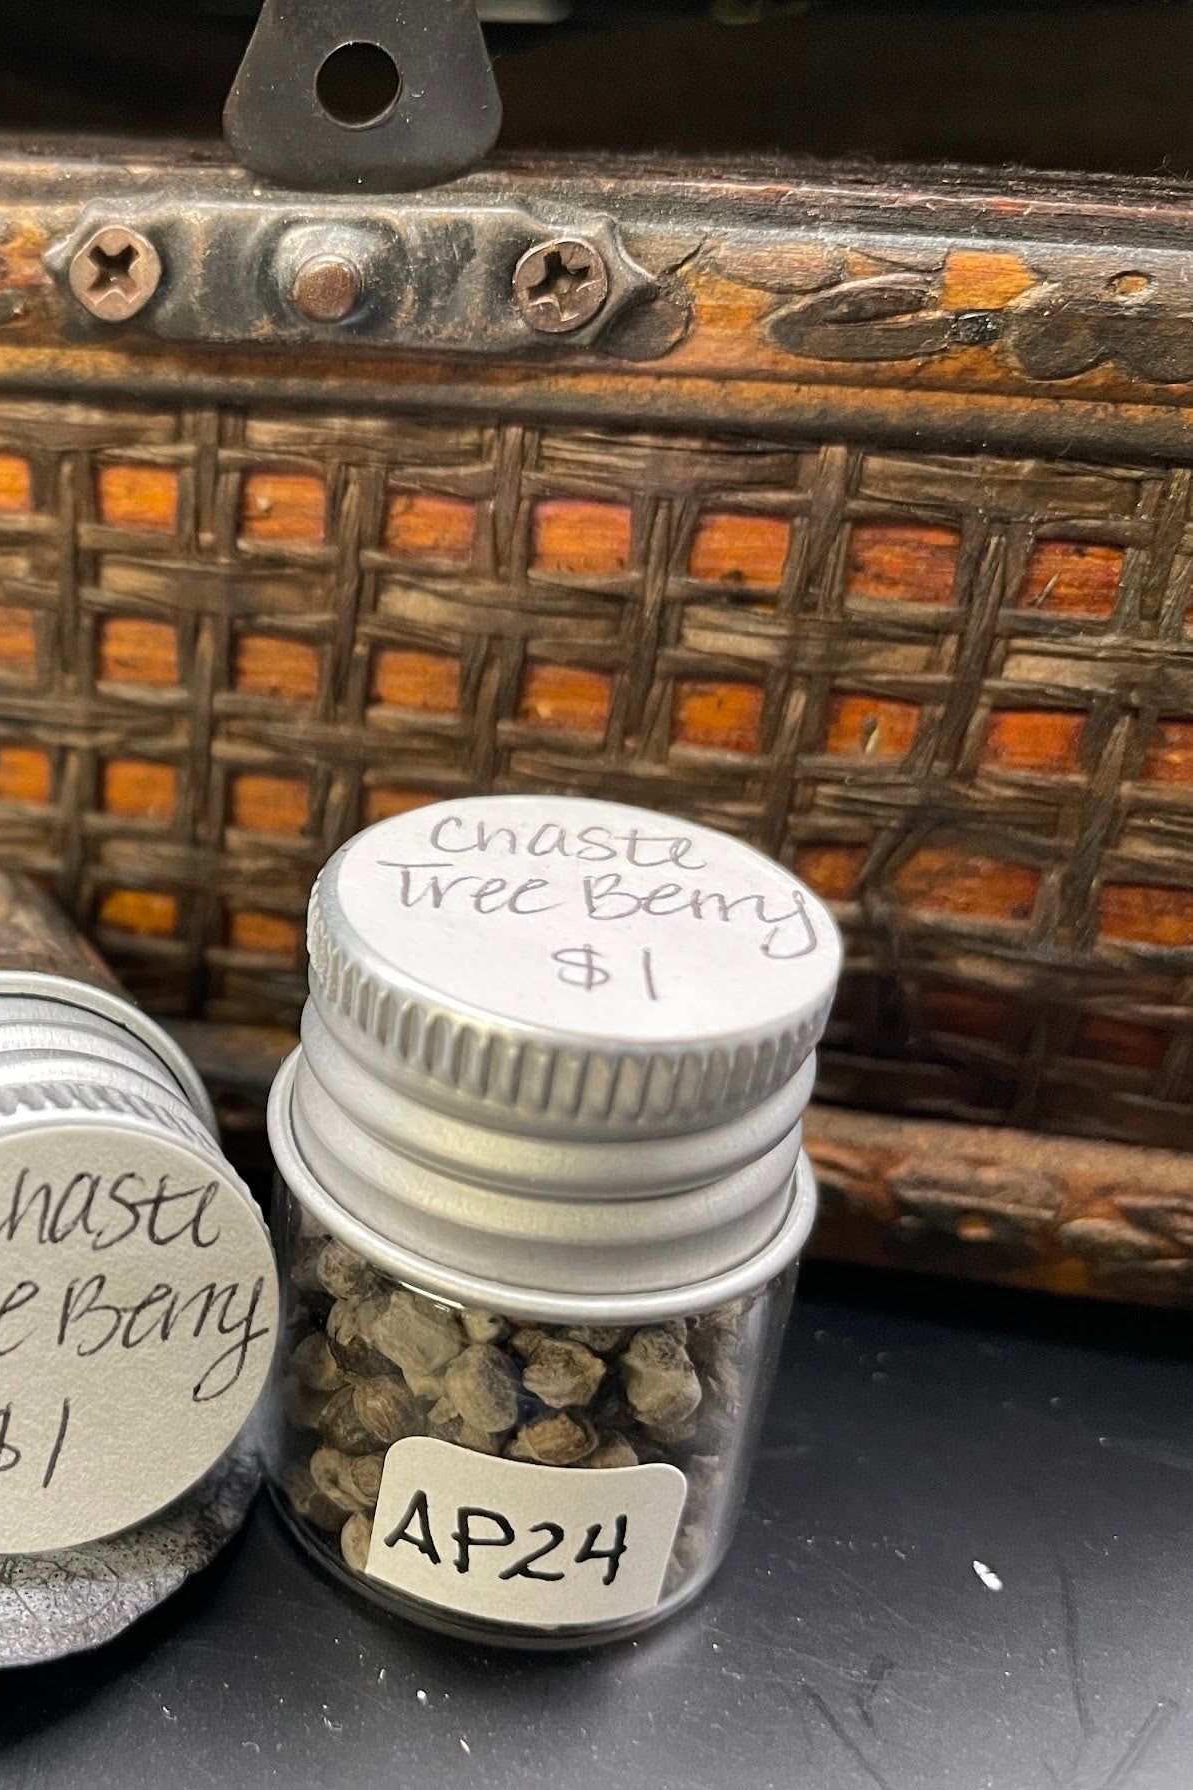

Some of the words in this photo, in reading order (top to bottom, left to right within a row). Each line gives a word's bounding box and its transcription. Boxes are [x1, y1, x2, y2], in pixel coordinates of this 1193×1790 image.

[429, 815, 706, 871] Chaste
[376, 860, 567, 916] Tree
[580, 872, 818, 960] Berry
[56, 1272, 270, 1403] Berry
[383, 1488, 628, 1586] AP24
